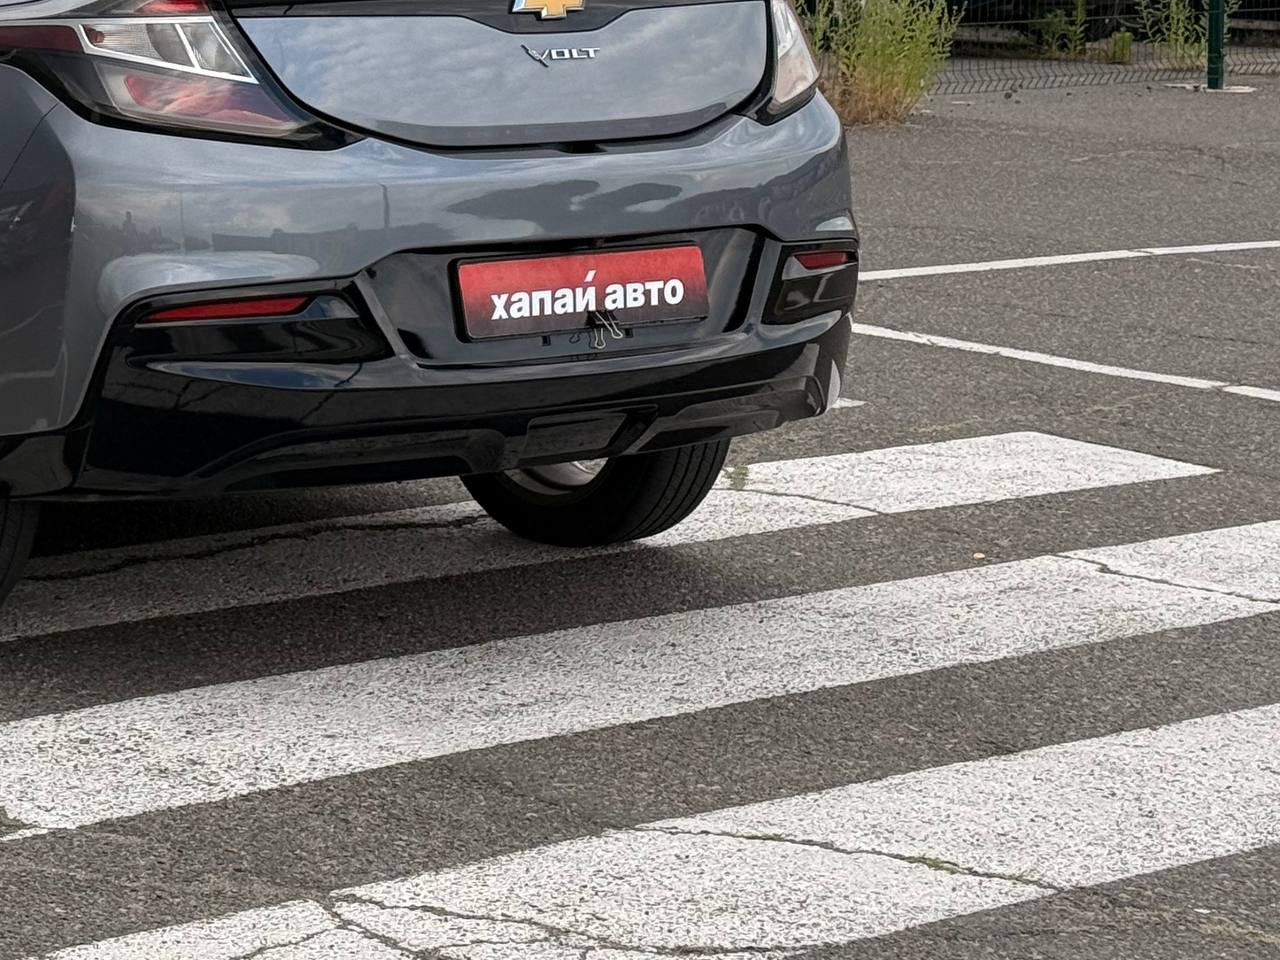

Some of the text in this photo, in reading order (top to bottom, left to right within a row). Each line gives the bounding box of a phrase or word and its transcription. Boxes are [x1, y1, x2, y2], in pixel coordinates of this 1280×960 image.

[521, 43, 600, 68] VOLT
[490, 270, 685, 321] хапай авто
